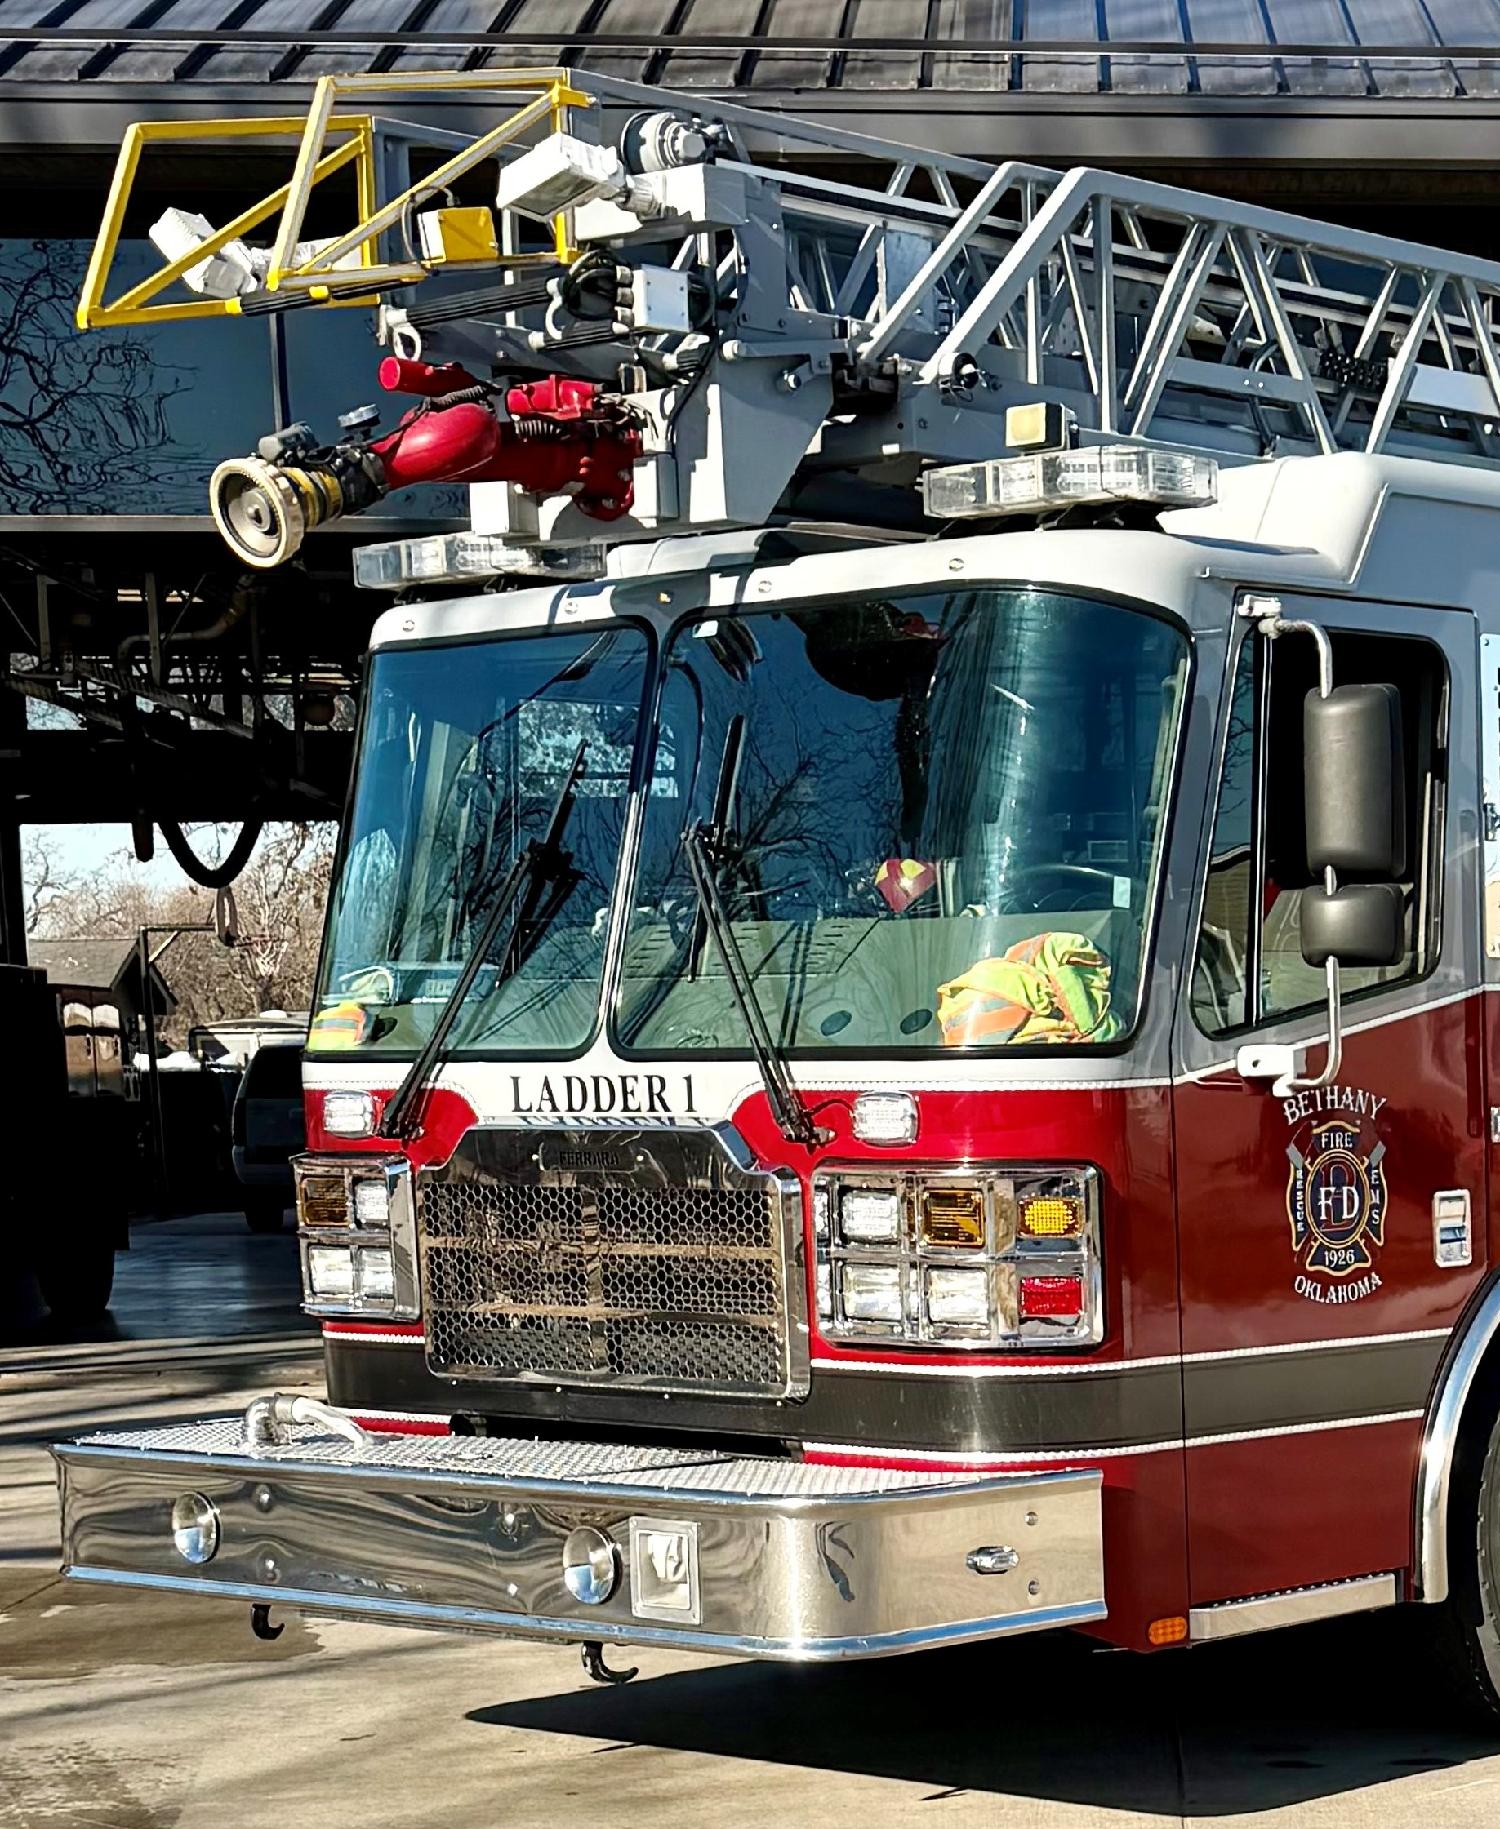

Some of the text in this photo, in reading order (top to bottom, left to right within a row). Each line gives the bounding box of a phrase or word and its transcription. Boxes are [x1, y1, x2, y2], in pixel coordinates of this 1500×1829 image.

[510, 1074, 697, 1113] LADDER 1
[1284, 1085, 1387, 1125] BETHANY
[1321, 1132, 1353, 1148] FIRE
[1317, 1186, 1360, 1220] FD
[1324, 1249, 1355, 1268] 1926
[1294, 1271, 1383, 1304] OKLAHOMA
